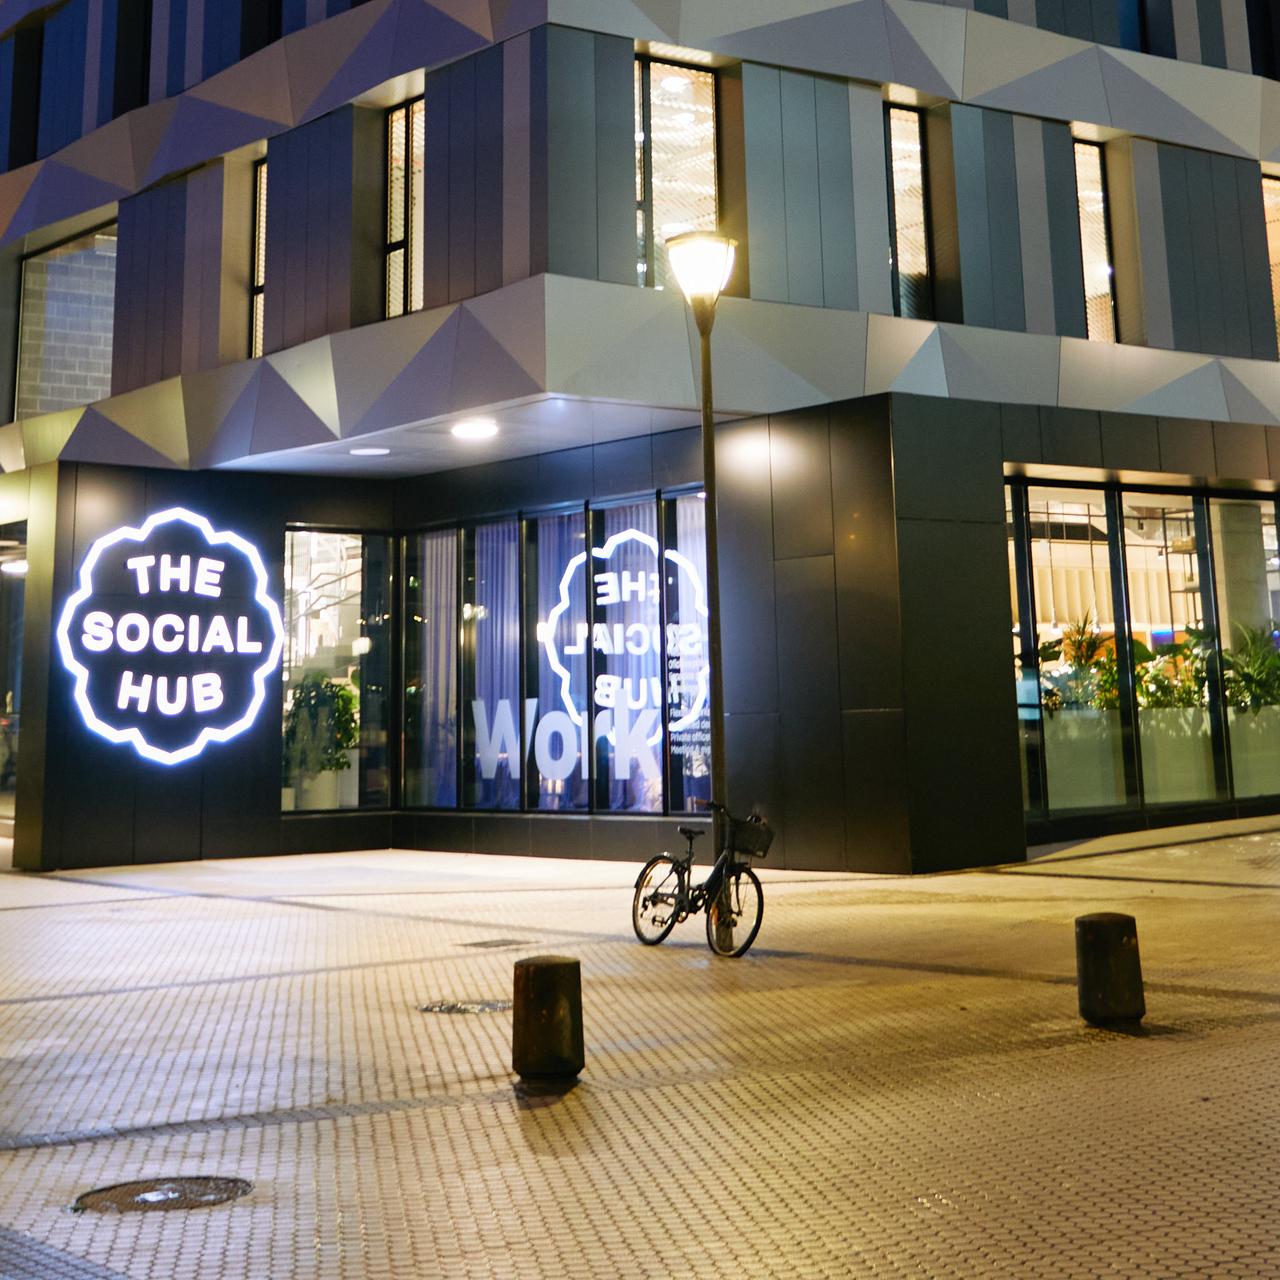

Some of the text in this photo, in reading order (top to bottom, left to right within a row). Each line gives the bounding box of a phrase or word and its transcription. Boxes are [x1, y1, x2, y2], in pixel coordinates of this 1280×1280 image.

[126, 554, 226, 598] THE
[81, 611, 263, 654] SOCIAL
[117, 670, 224, 715] HUB
[472, 689, 662, 780] Work
